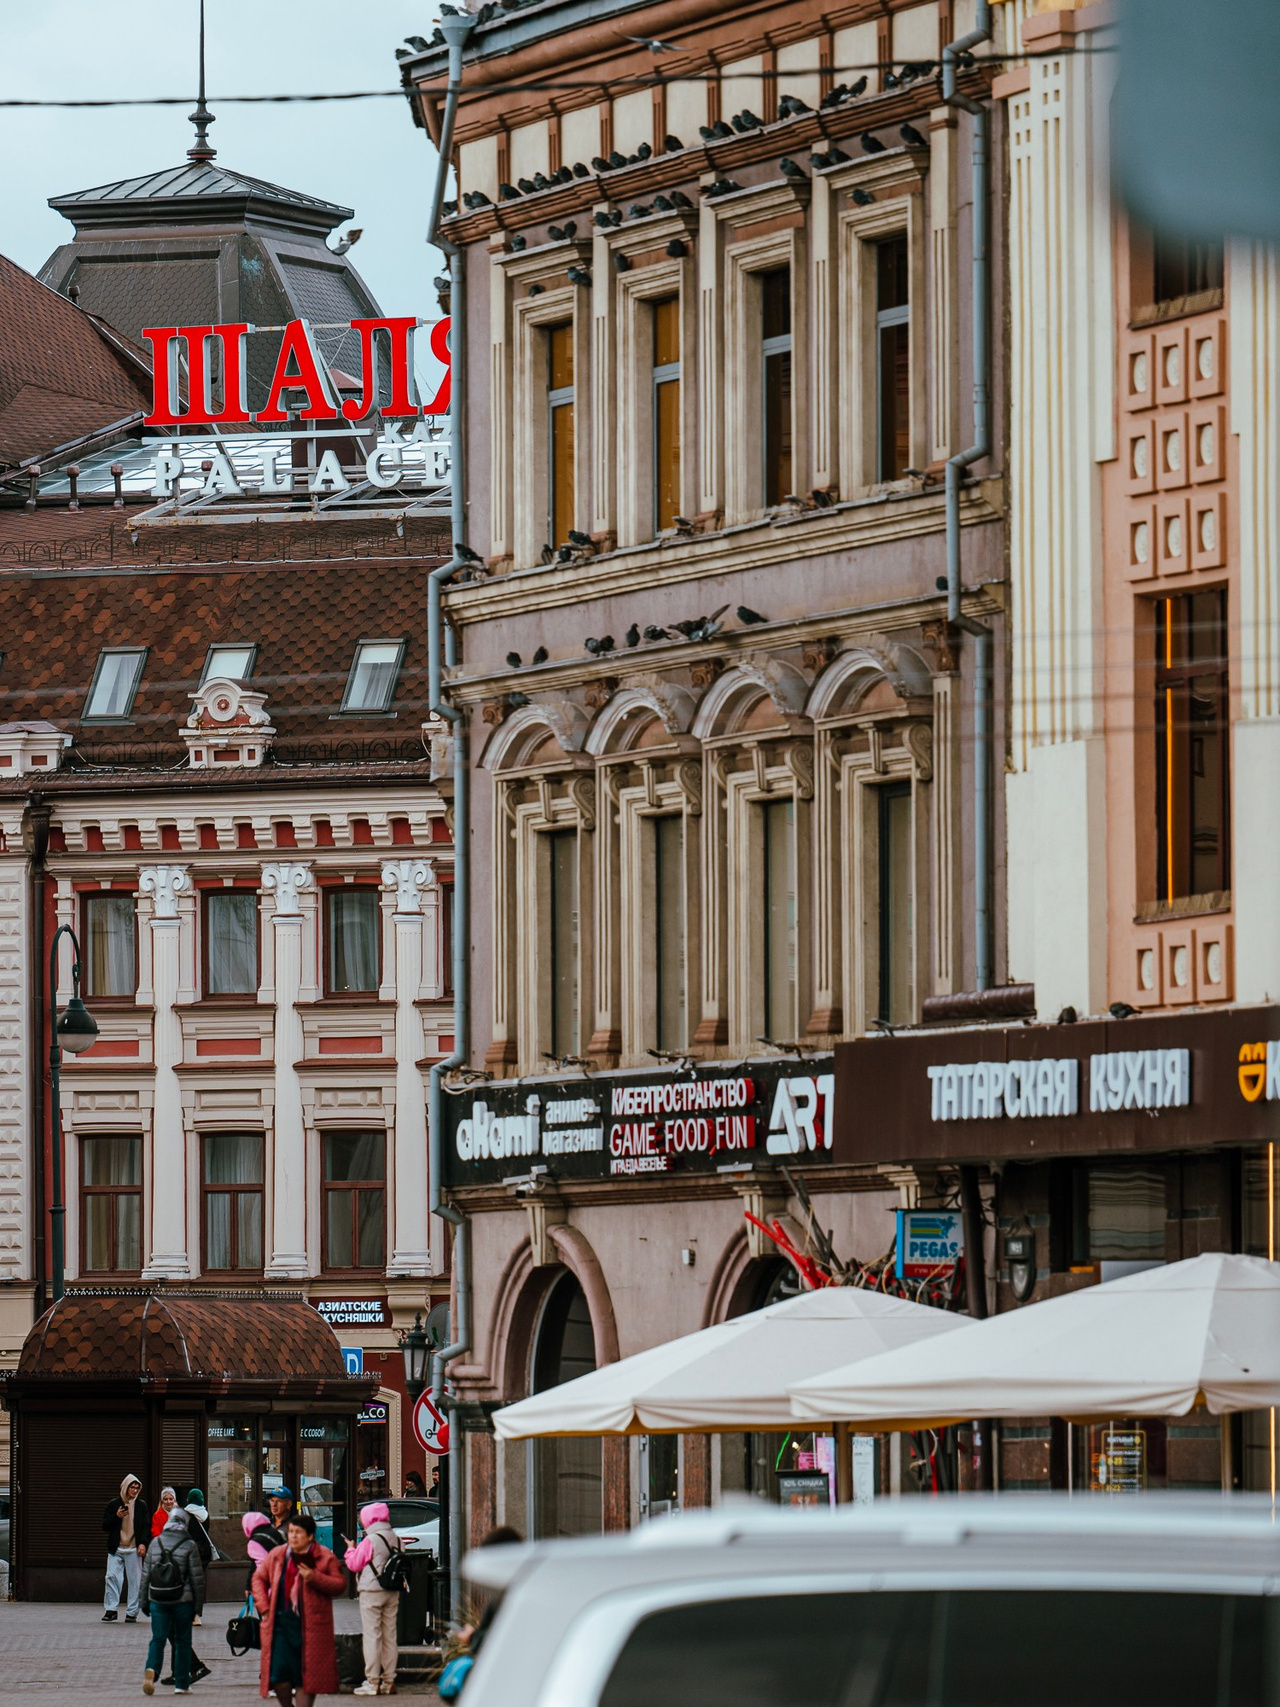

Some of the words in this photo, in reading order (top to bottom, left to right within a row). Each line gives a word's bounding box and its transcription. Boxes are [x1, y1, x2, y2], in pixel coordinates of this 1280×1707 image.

[150, 445, 451, 497] PALACE
[611, 1078, 747, 1116] КИБЕРПРОСТРАНСТВО
[927, 1058, 1078, 1122] ТАТАРСКАЯ
[1090, 1048, 1190, 1113] КУХНЯ
[456, 1094, 541, 1161] akami
[542, 1127, 603, 1157] магазин
[715, 1116, 748, 1150] FUN
[909, 1241, 959, 1258] PEGAS
[317, 1301, 382, 1312] АЗИАТСКИЕ
[319, 1313, 384, 1323] КУСНЯШКИ
[360, 1407, 385, 1419] LCO
[208, 1427, 223, 1437] OFFEE
[224, 1427, 235, 1437] LIKE
